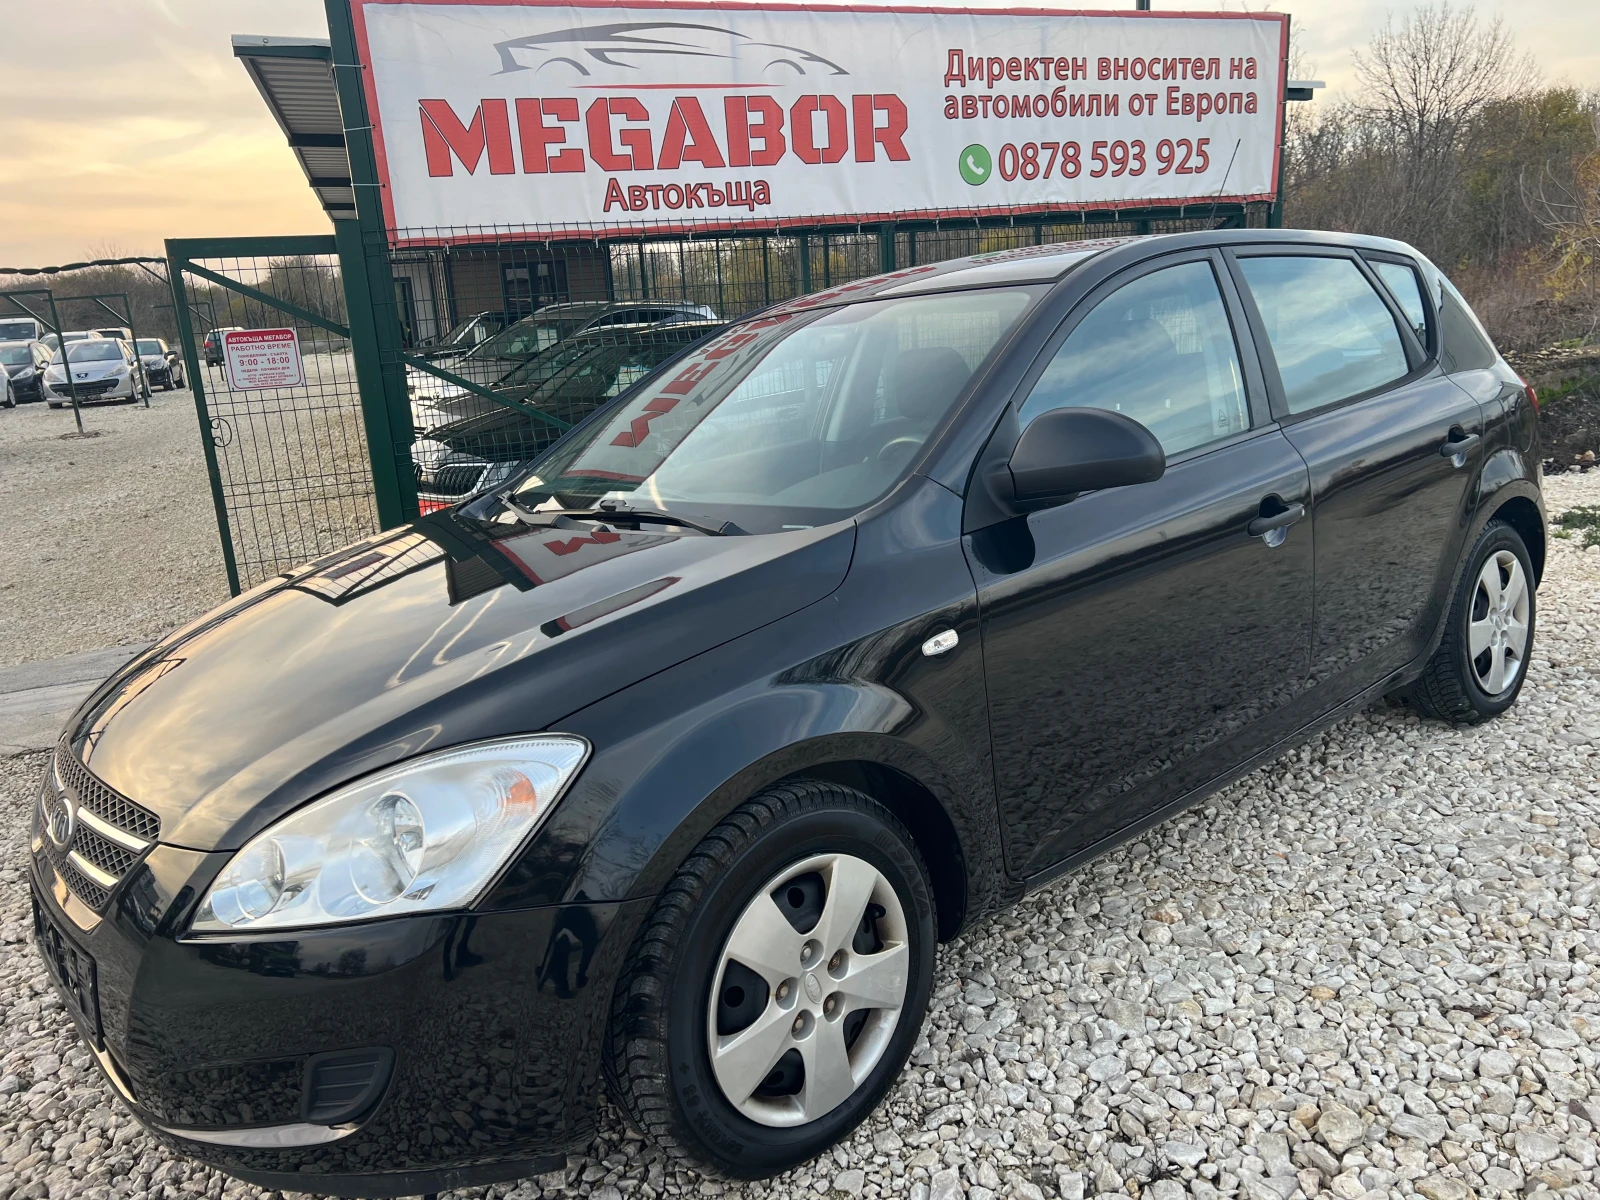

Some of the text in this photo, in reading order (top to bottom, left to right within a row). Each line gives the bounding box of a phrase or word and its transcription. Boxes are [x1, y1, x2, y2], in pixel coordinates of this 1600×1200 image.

[944, 49, 1257, 88] Директен вносител на
[944, 85, 1258, 122] автомобили от Европа
[418, 94, 910, 177] MEGABOR
[998, 138, 1211, 182] 0878 593 925
[603, 178, 771, 211] Автокъща
[228, 335, 263, 343] АВТОКЪЩА
[231, 344, 265, 352] РАБОТНО
[267, 356, 290, 364] 18:00
[889, 847, 930, 922] SAVA
